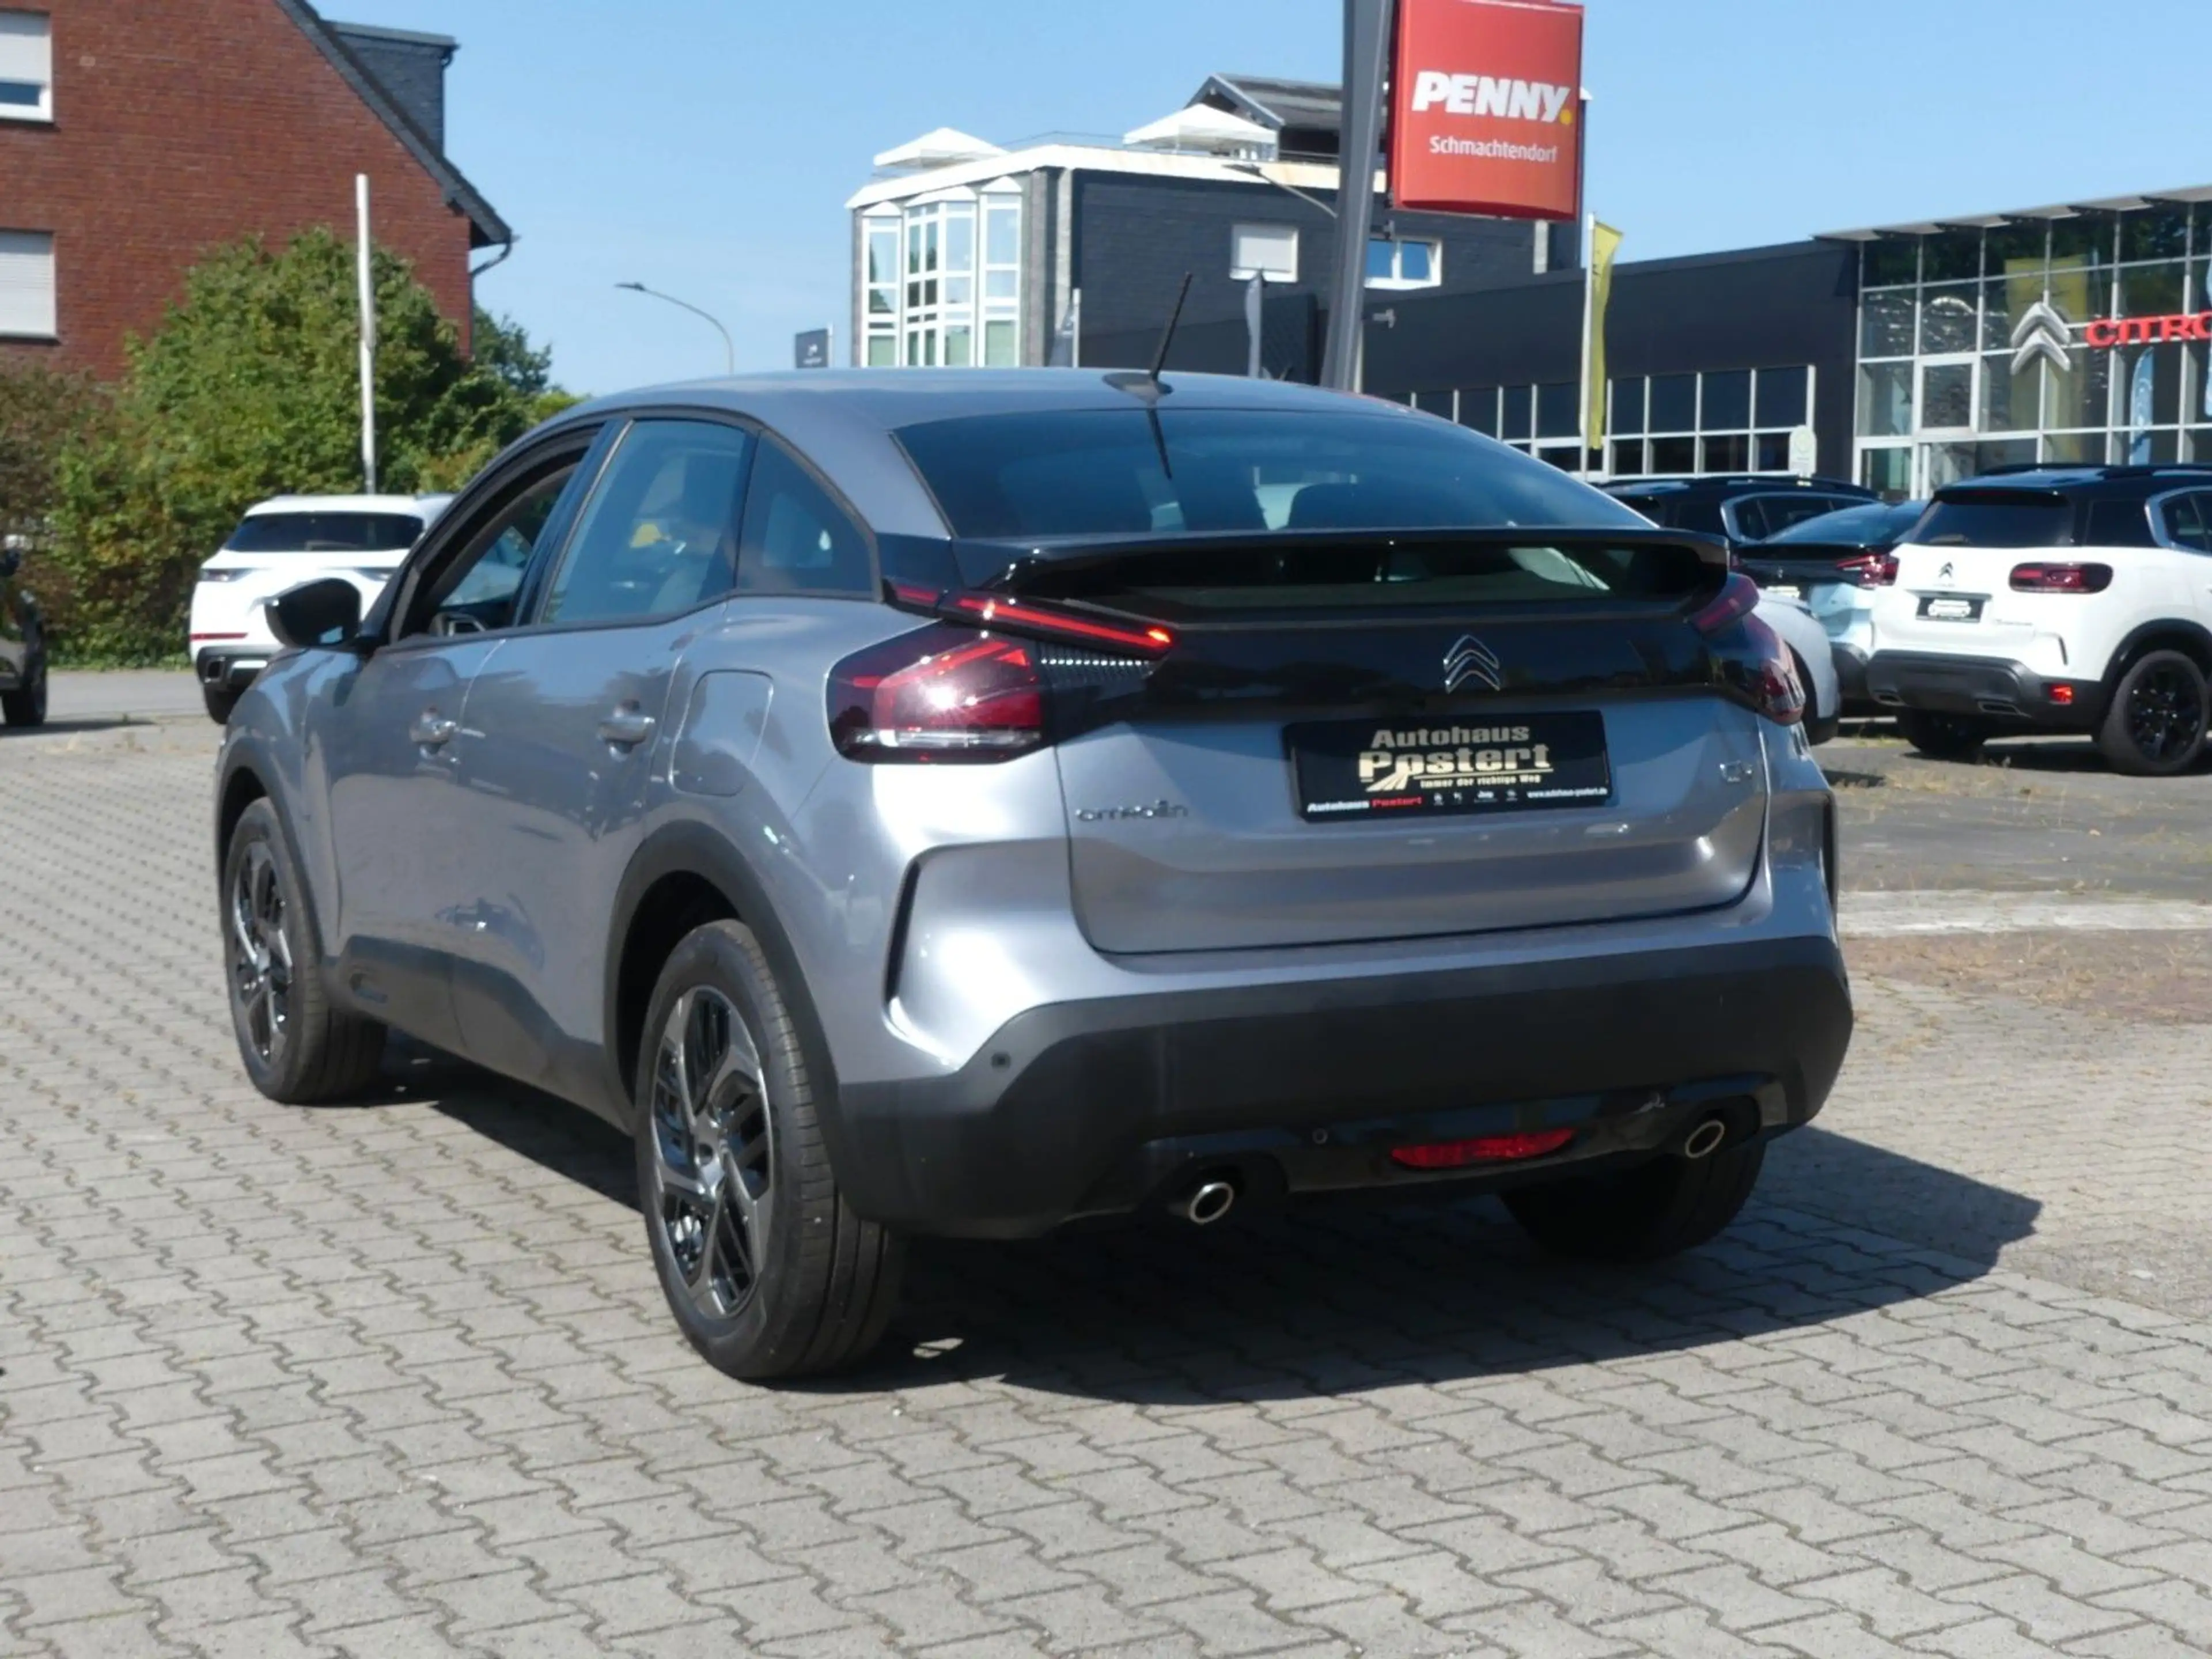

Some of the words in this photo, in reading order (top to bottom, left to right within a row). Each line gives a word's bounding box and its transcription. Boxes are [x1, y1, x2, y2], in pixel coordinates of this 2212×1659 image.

[1429, 136, 1558, 162] Schmachtendorf
[1371, 726, 1529, 748] Autohaus
[1359, 744, 1550, 781] Postert
